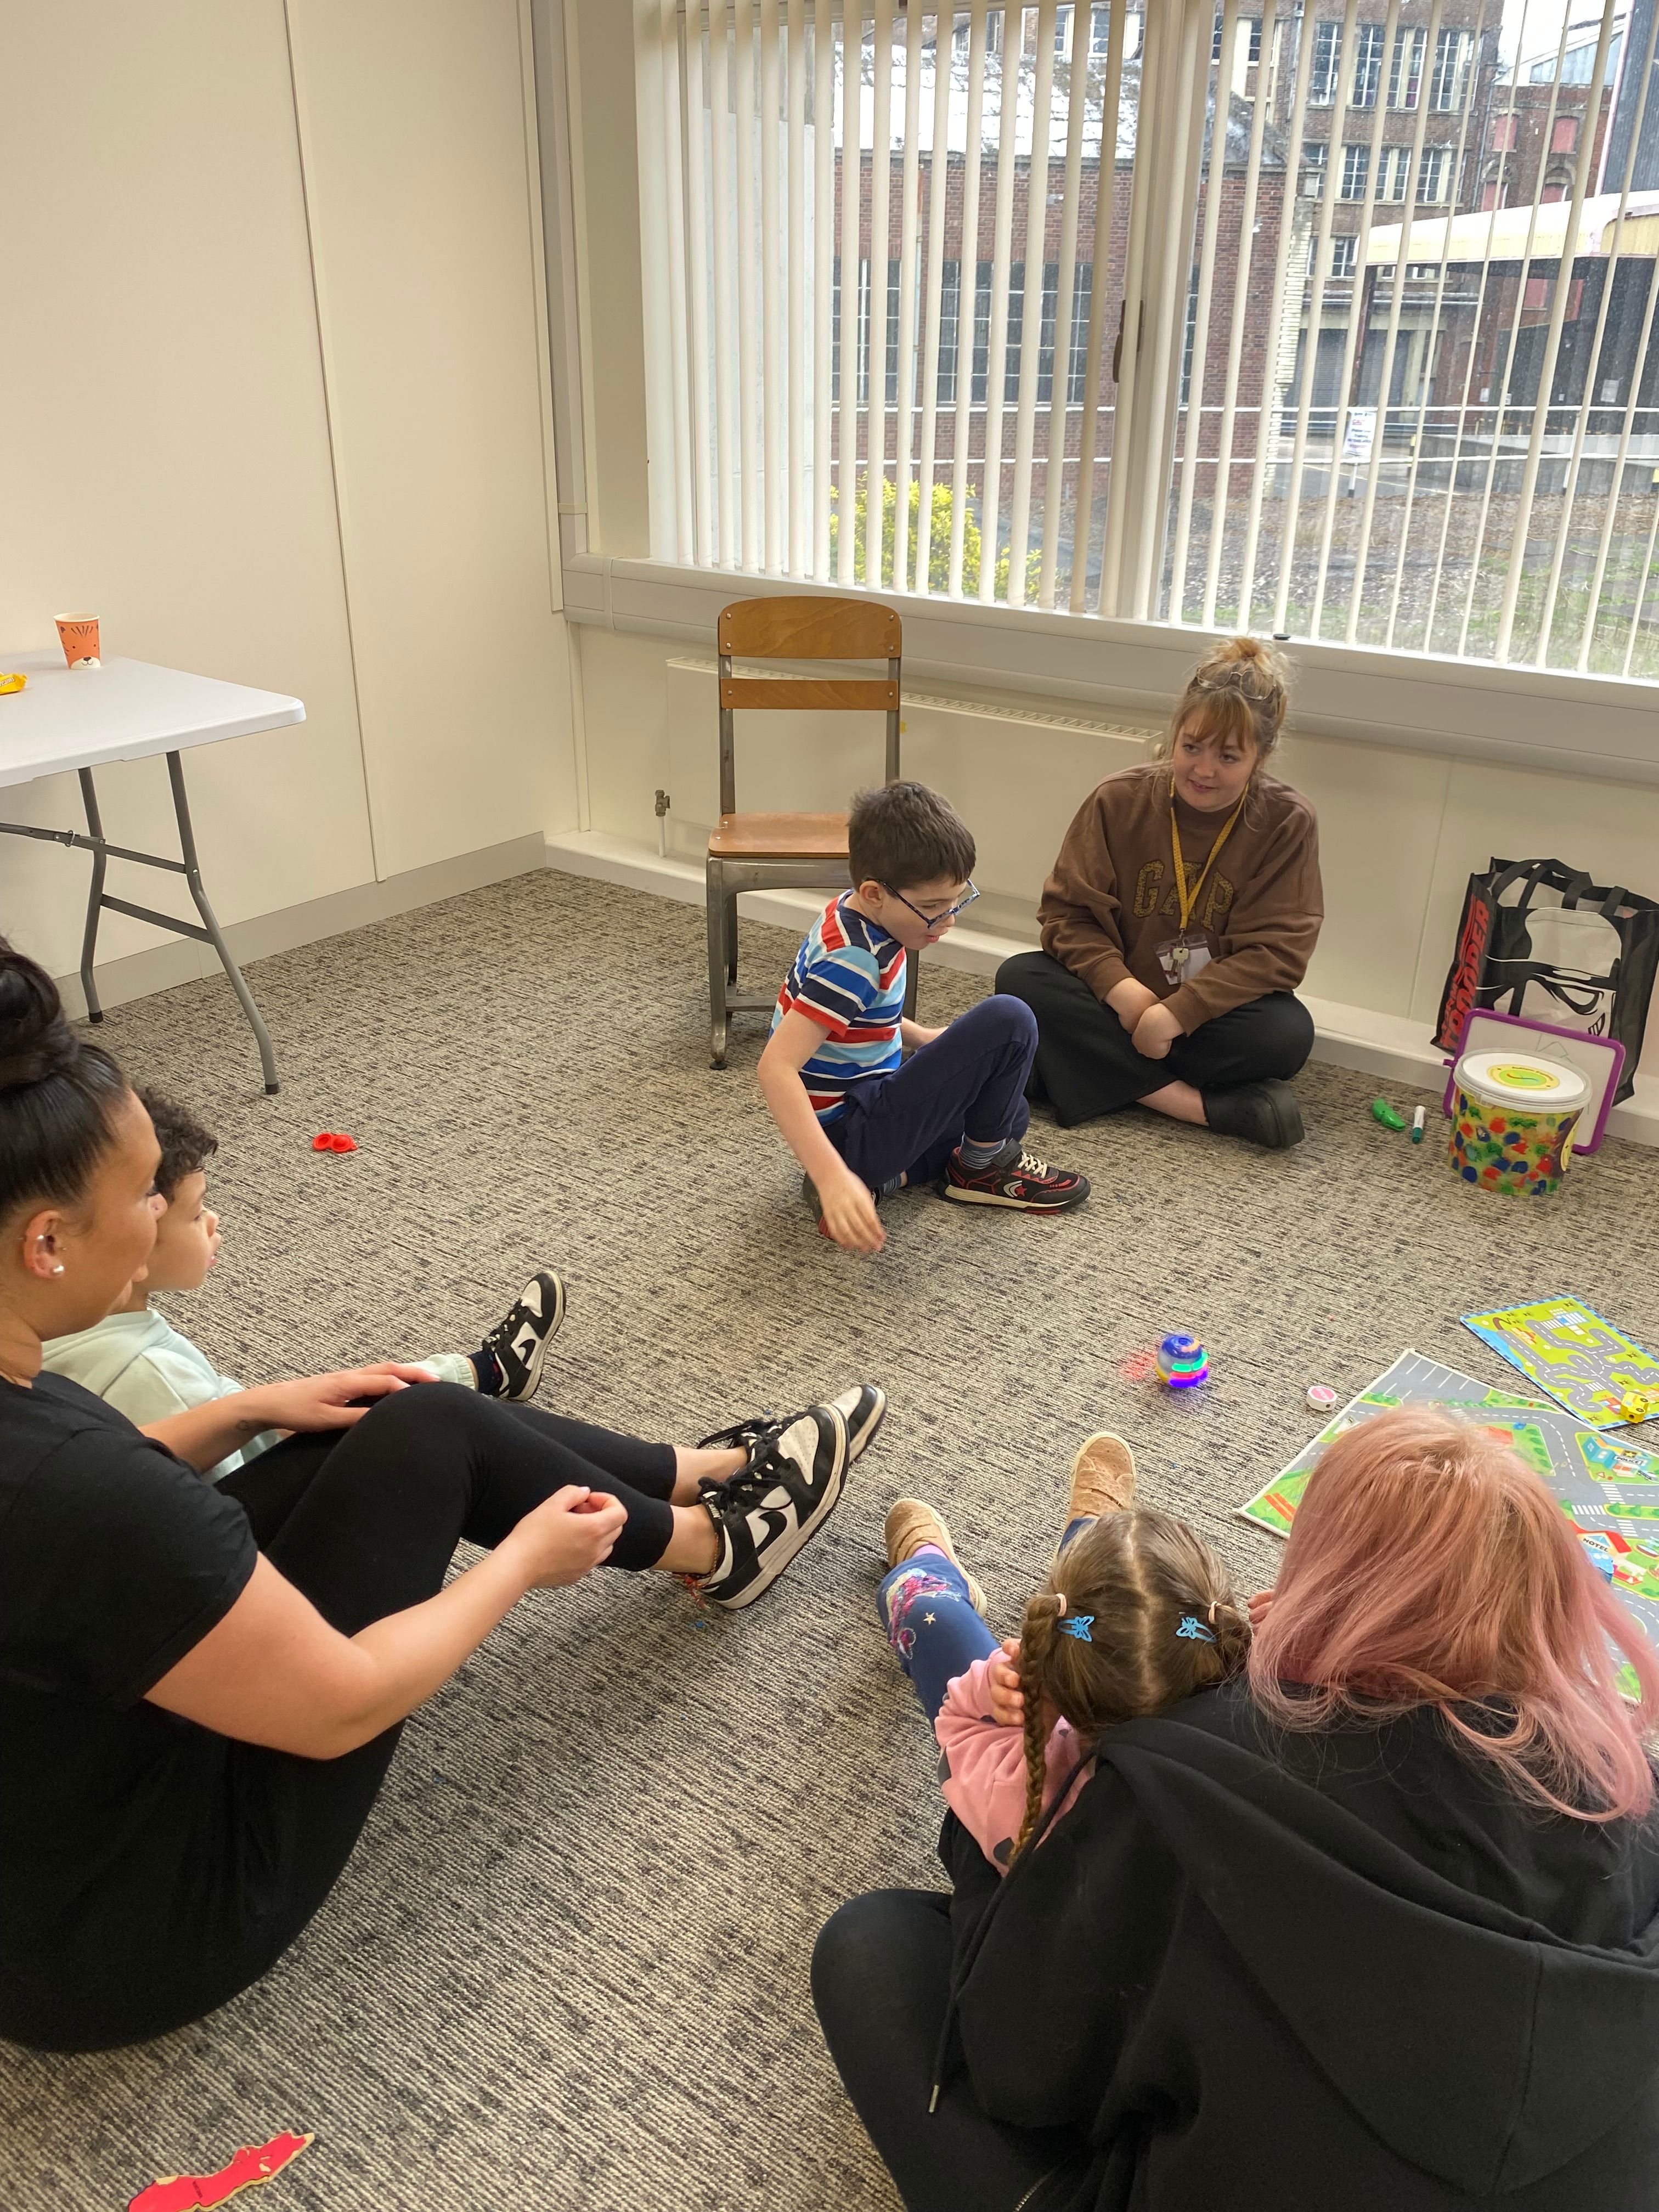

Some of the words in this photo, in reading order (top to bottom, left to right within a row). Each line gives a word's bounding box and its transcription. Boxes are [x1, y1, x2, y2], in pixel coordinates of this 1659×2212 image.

[1133, 860, 1234, 932] GAP
[1442, 900, 1489, 1048] TROOPER
[1316, 1388, 1330, 1400] STOP
[1583, 1538, 1609, 1552] HOTEL
